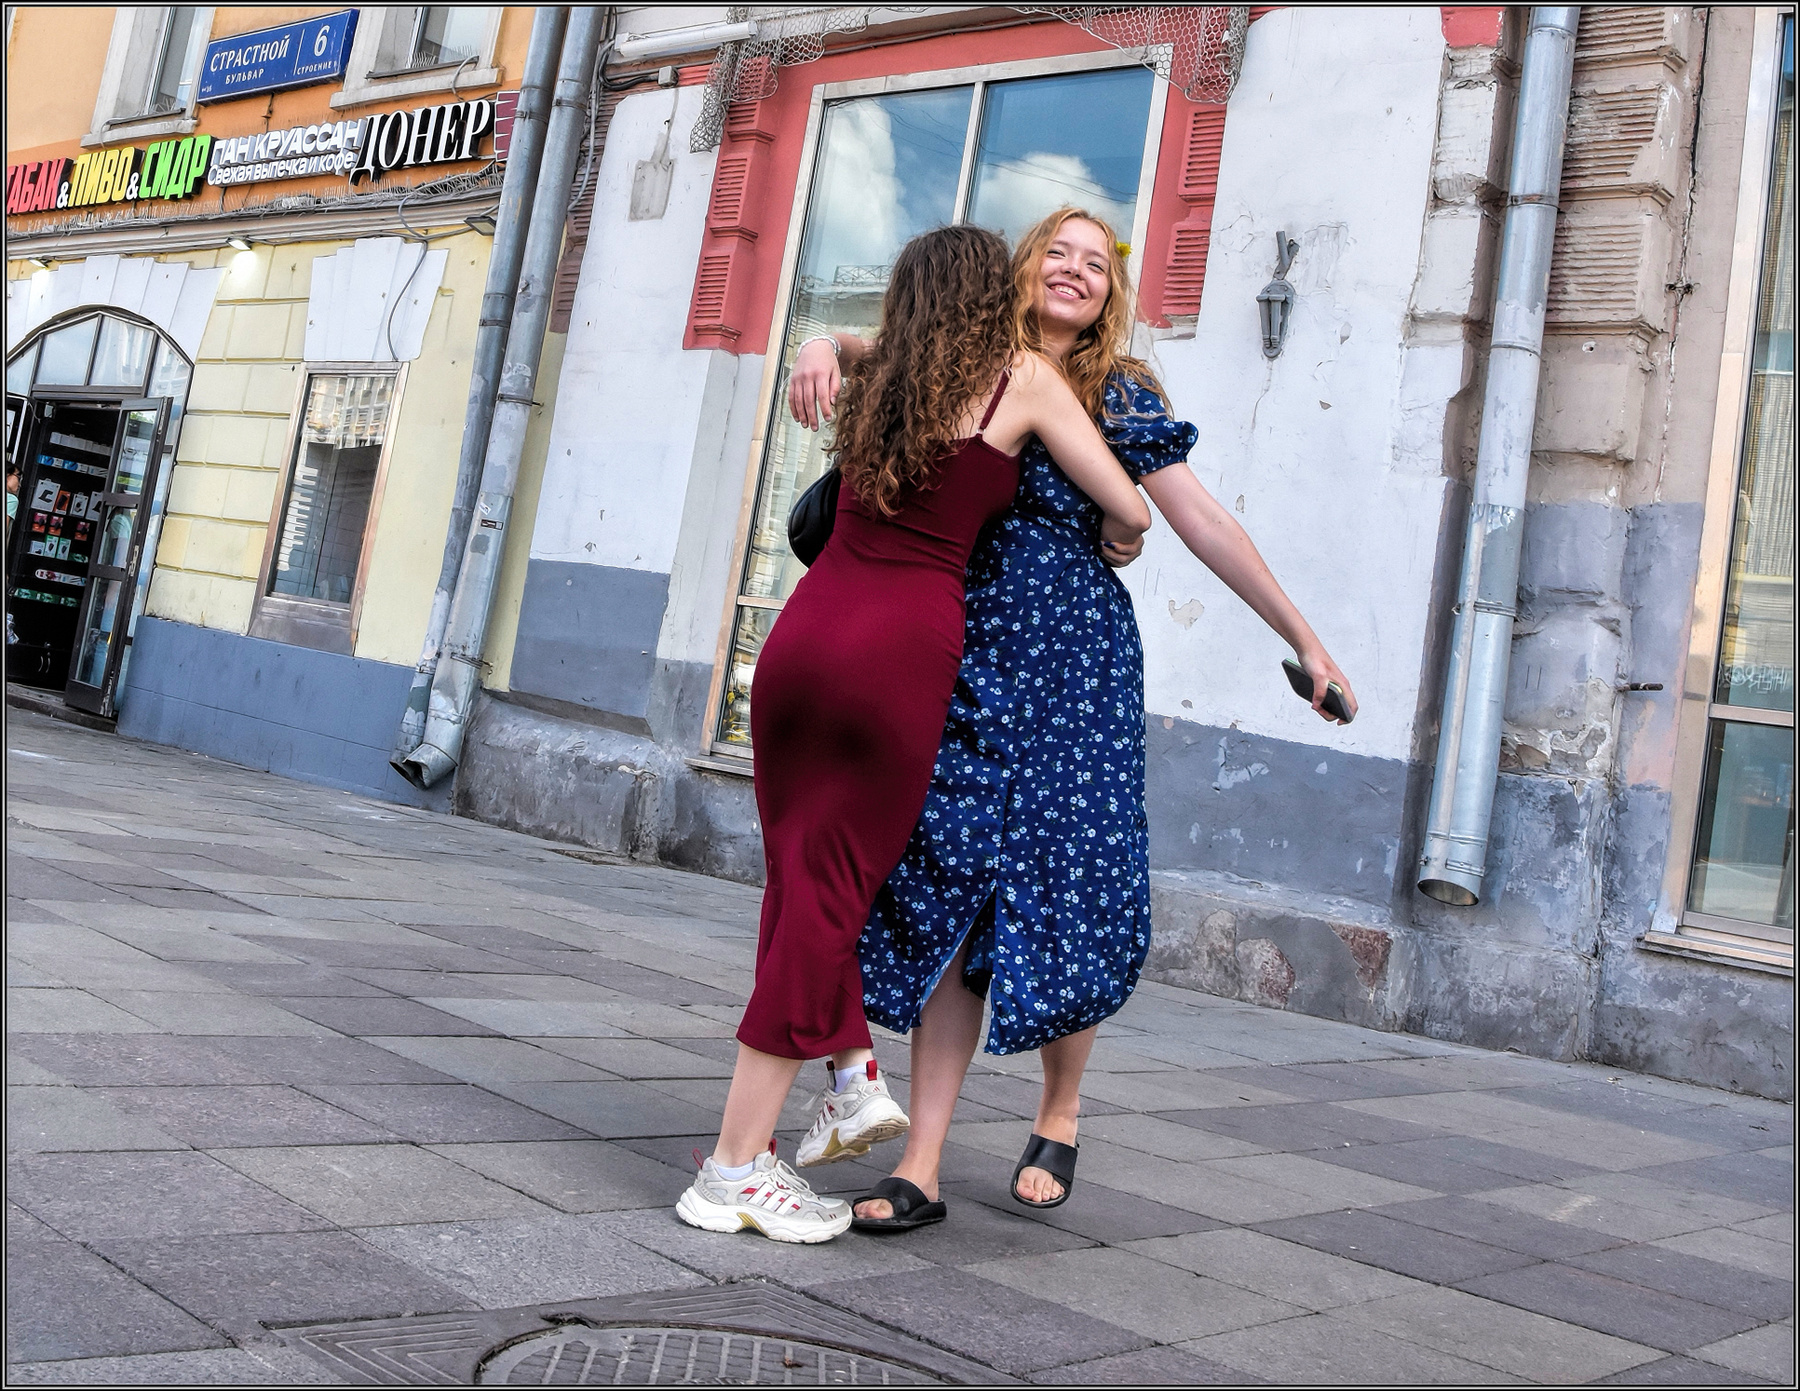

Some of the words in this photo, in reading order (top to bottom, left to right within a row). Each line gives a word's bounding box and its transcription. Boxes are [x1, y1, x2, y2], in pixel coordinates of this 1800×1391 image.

[210, 34, 291, 73] СТРАСТНОЙ
[313, 25, 330, 57] 6
[225, 68, 265, 85] БУЛЬВАР
[296, 61, 332, 76] СТРОЕНИЕ
[212, 141, 250, 167] ПАН
[253, 120, 365, 159] КРУАССАН
[350, 99, 491, 184] ДОНЕР
[68, 146, 135, 207] ПИВО
[138, 134, 212, 200] СИДР
[208, 162, 254, 186] Свежая
[254, 150, 309, 180] выпечка
[309, 151, 318, 172] и
[319, 147, 356, 174] кофе
